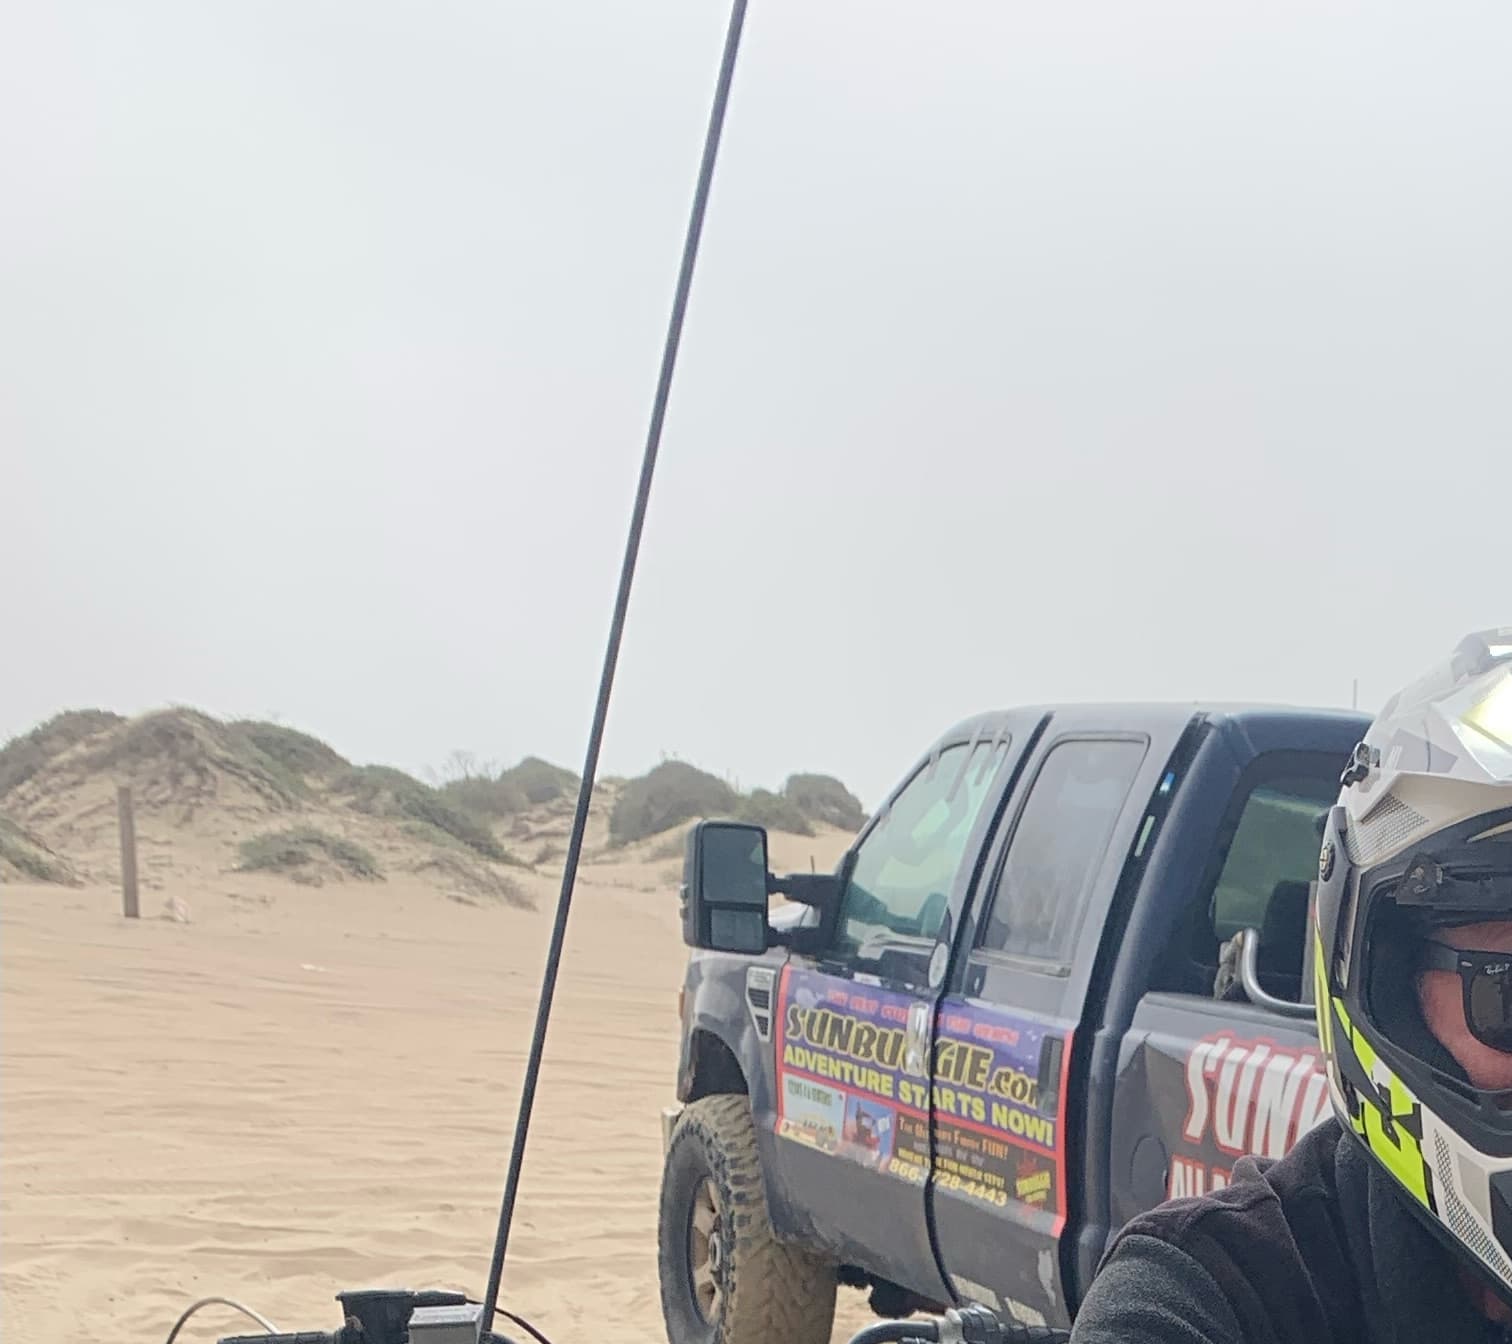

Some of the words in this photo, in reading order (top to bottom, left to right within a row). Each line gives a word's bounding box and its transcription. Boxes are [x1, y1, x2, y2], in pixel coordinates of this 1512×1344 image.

[784, 1044, 894, 1097] ADVENTURE
[899, 1081, 986, 1123] STARTS
[992, 1101, 1054, 1147] NOW!
